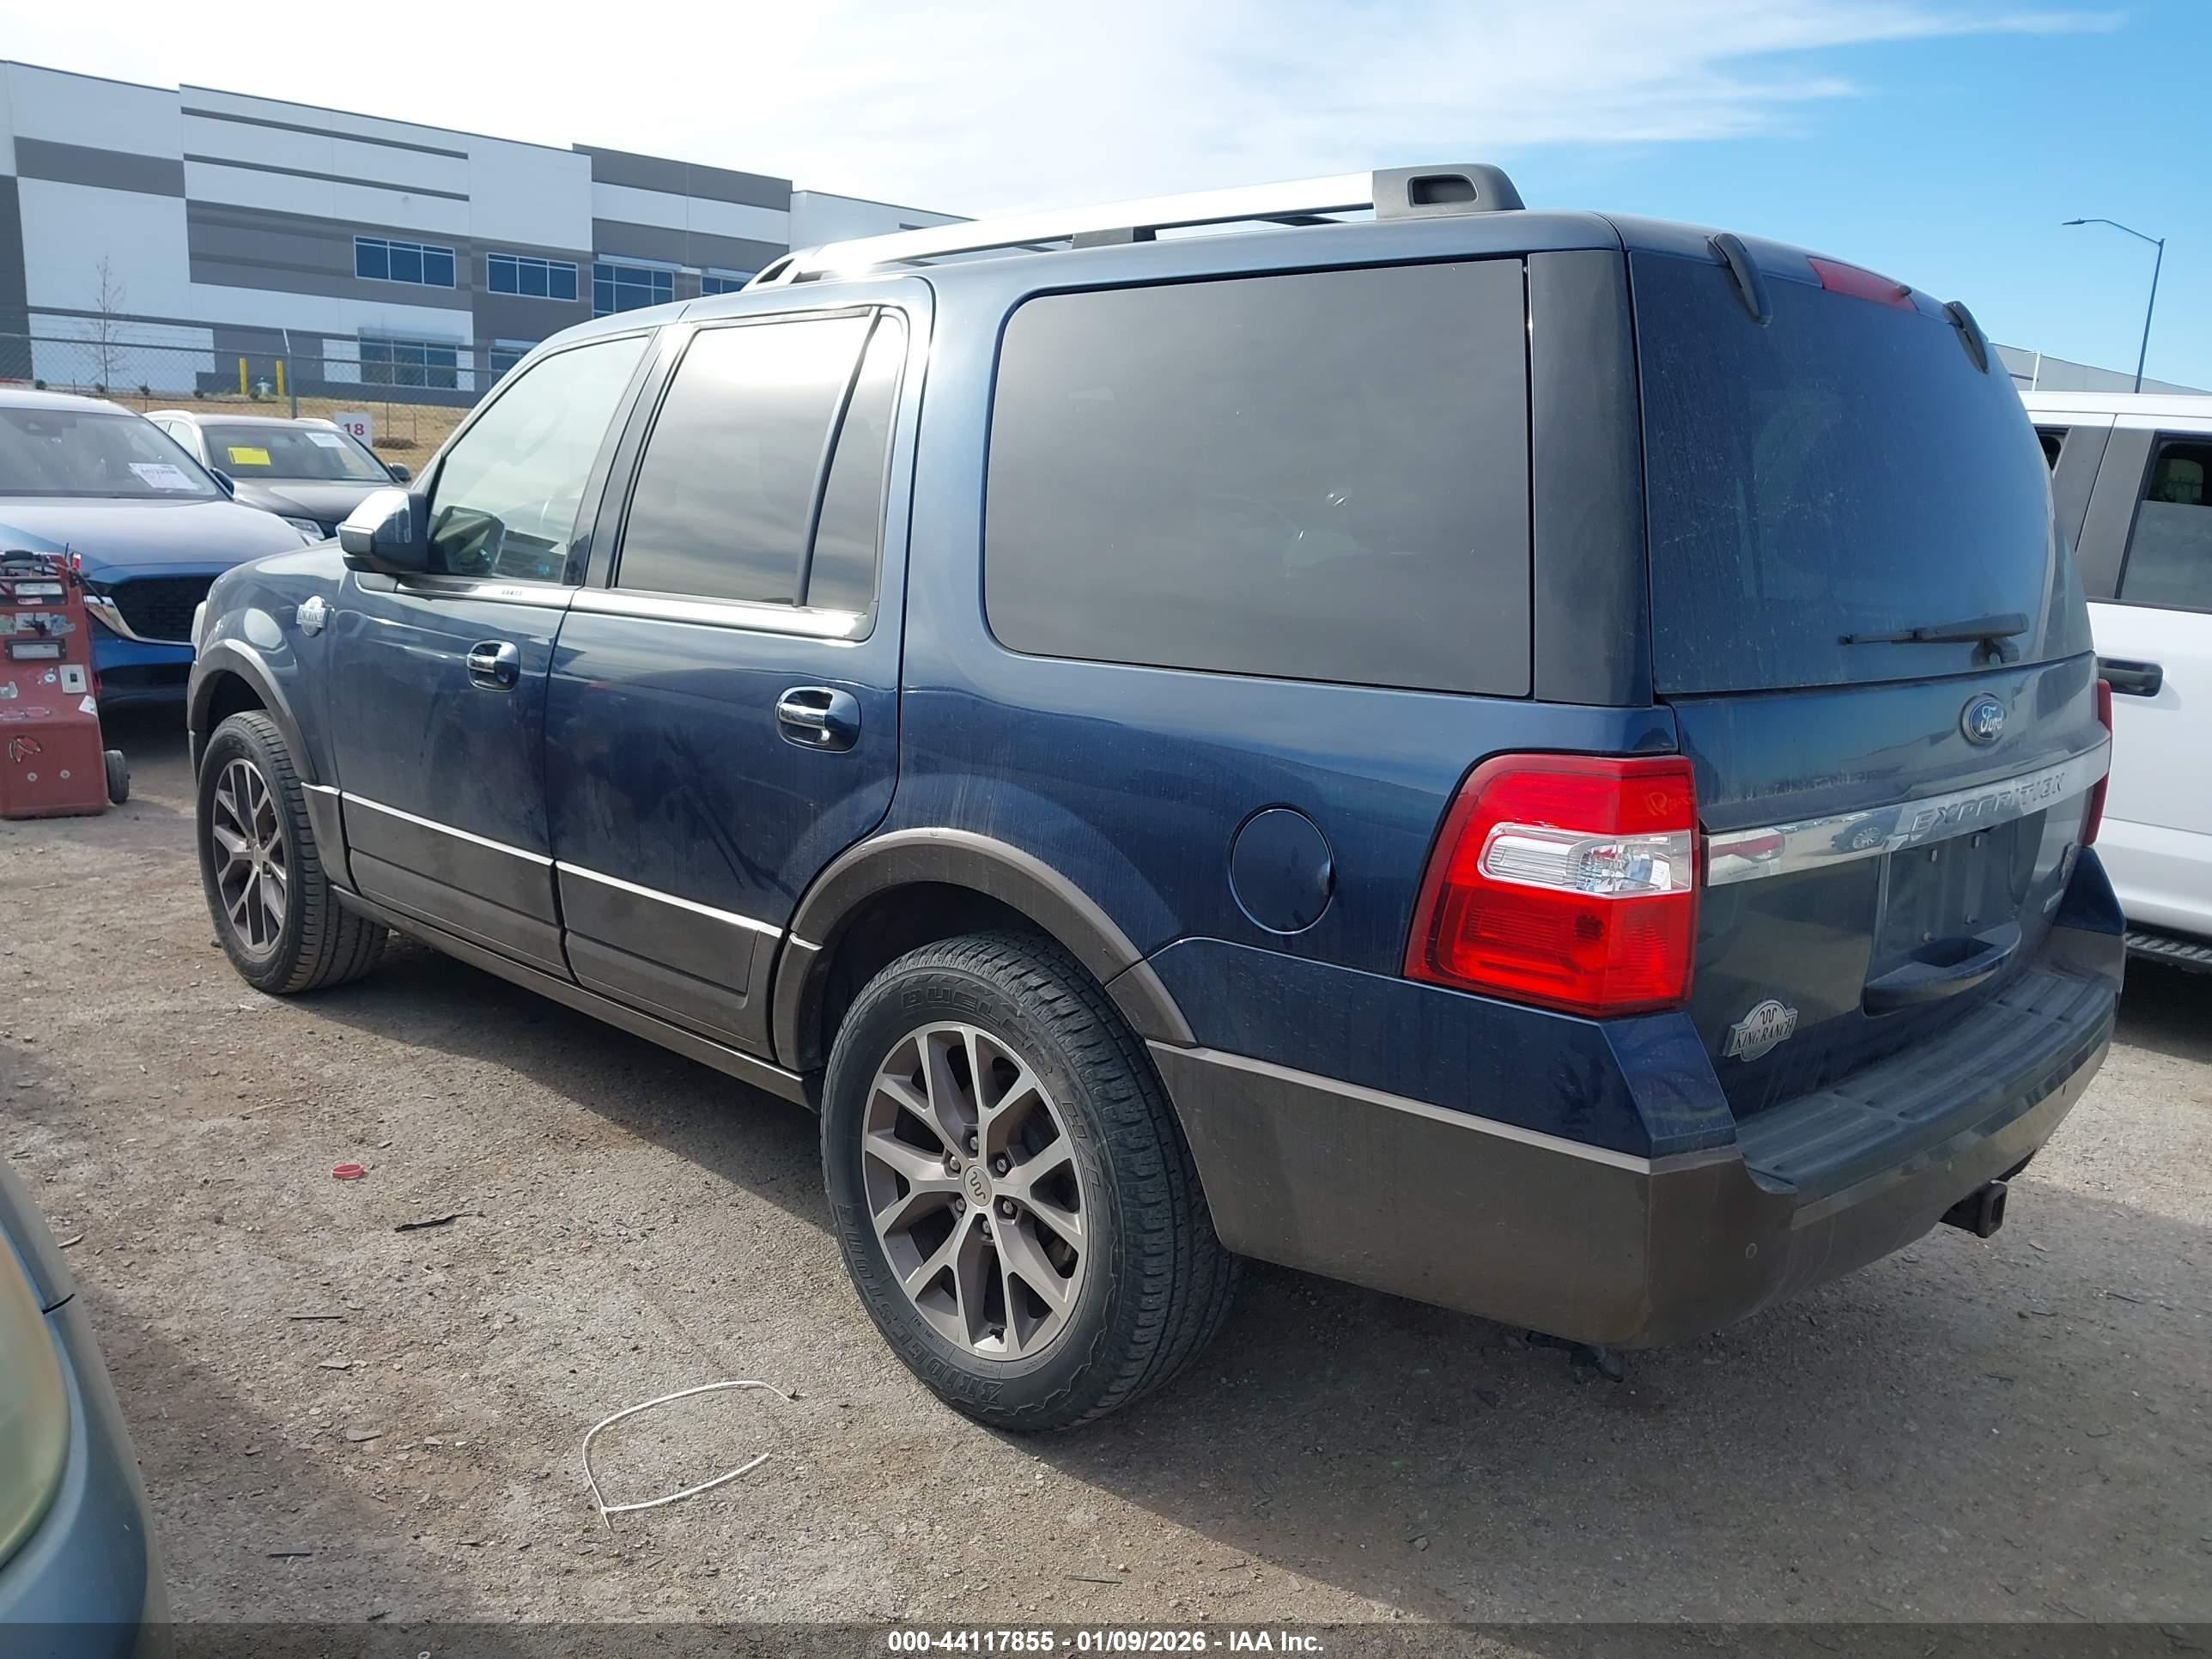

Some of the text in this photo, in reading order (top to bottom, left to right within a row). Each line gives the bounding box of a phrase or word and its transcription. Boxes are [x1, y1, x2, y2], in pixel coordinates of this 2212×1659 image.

[343, 422, 365, 436] 18
[1980, 705, 2003, 732] Ford
[1735, 1016, 1795, 1049] KING RANCH
